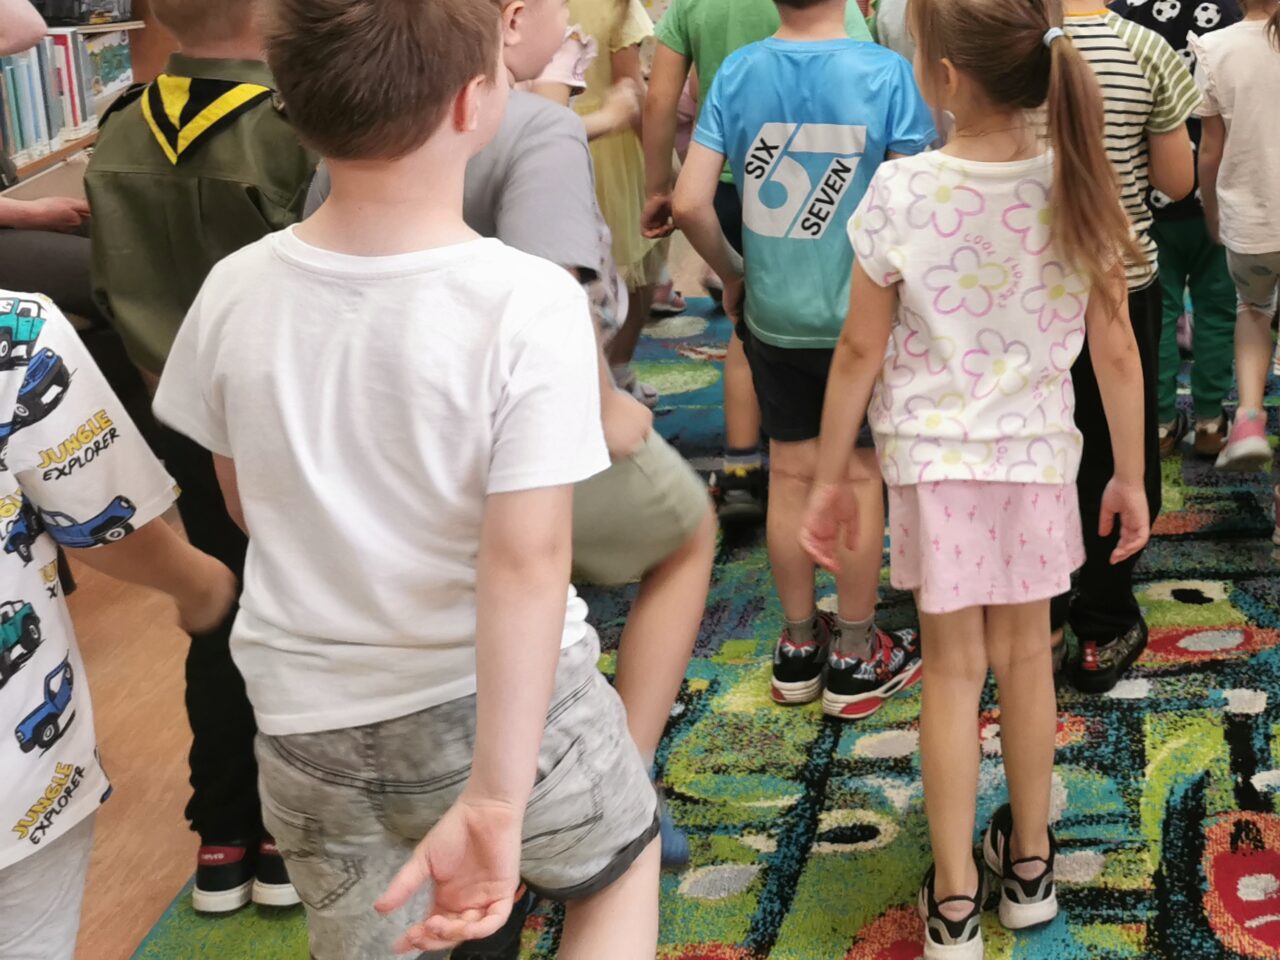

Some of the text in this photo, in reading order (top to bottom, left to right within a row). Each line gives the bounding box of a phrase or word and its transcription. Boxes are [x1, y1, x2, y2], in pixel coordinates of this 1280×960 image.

[742, 122, 867, 240] 67
[744, 137, 780, 179] SIX
[800, 158, 852, 236] SEVEN
[37, 409, 114, 469] JUNGLE
[42, 427, 120, 481] EXPLORER
[11, 761, 74, 840] JUNGLE
[29, 766, 85, 845] EXPLORER
